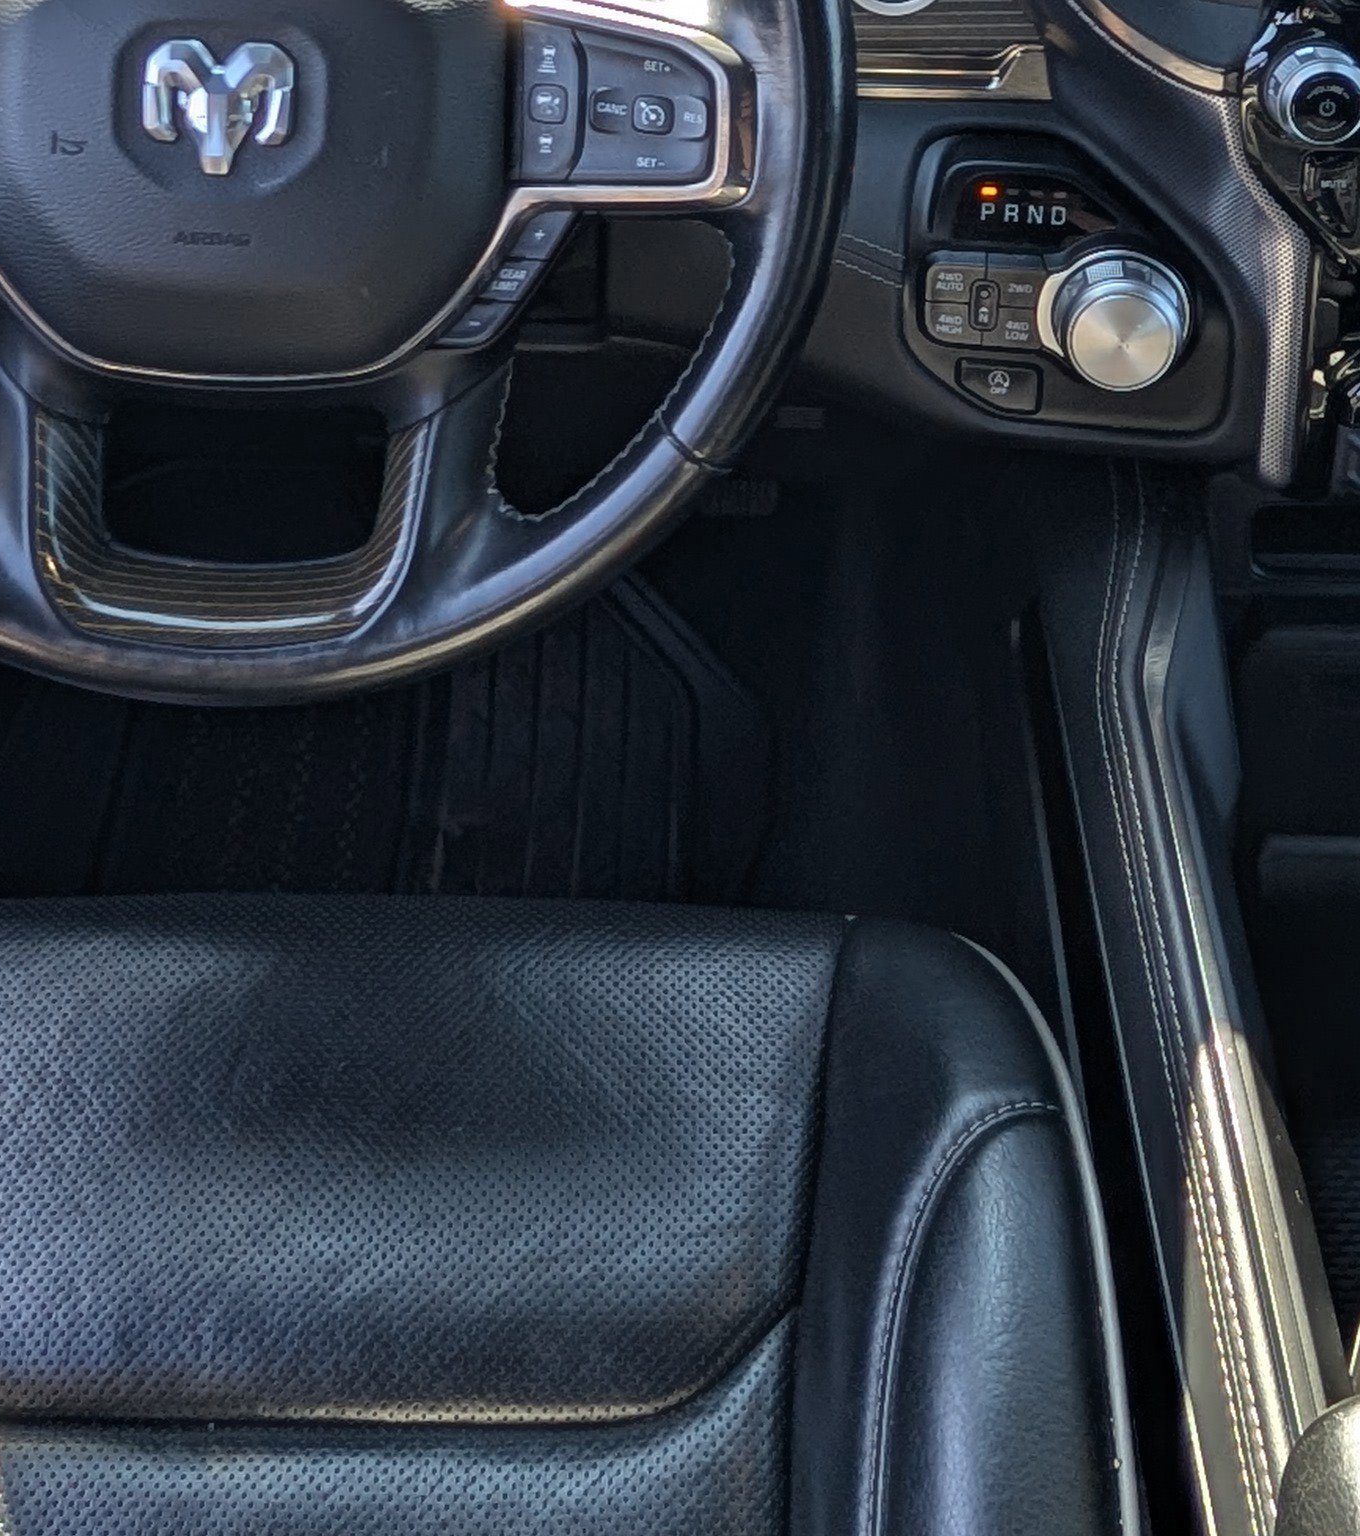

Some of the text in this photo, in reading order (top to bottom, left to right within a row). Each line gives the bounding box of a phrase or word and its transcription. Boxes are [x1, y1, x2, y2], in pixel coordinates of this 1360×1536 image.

[597, 101, 628, 115] CANC
[683, 111, 703, 123] RES
[980, 203, 1066, 225] P R N D
[173, 231, 252, 247] AIRBAG
[938, 272, 964, 282] 4WD
[935, 281, 964, 292] AUTO
[1007, 283, 1033, 294] 2WD
[938, 314, 963, 325] 4WD
[936, 323, 963, 334] HIGH
[1005, 321, 1029, 332] 4WD
[1005, 331, 1029, 342] LOW
